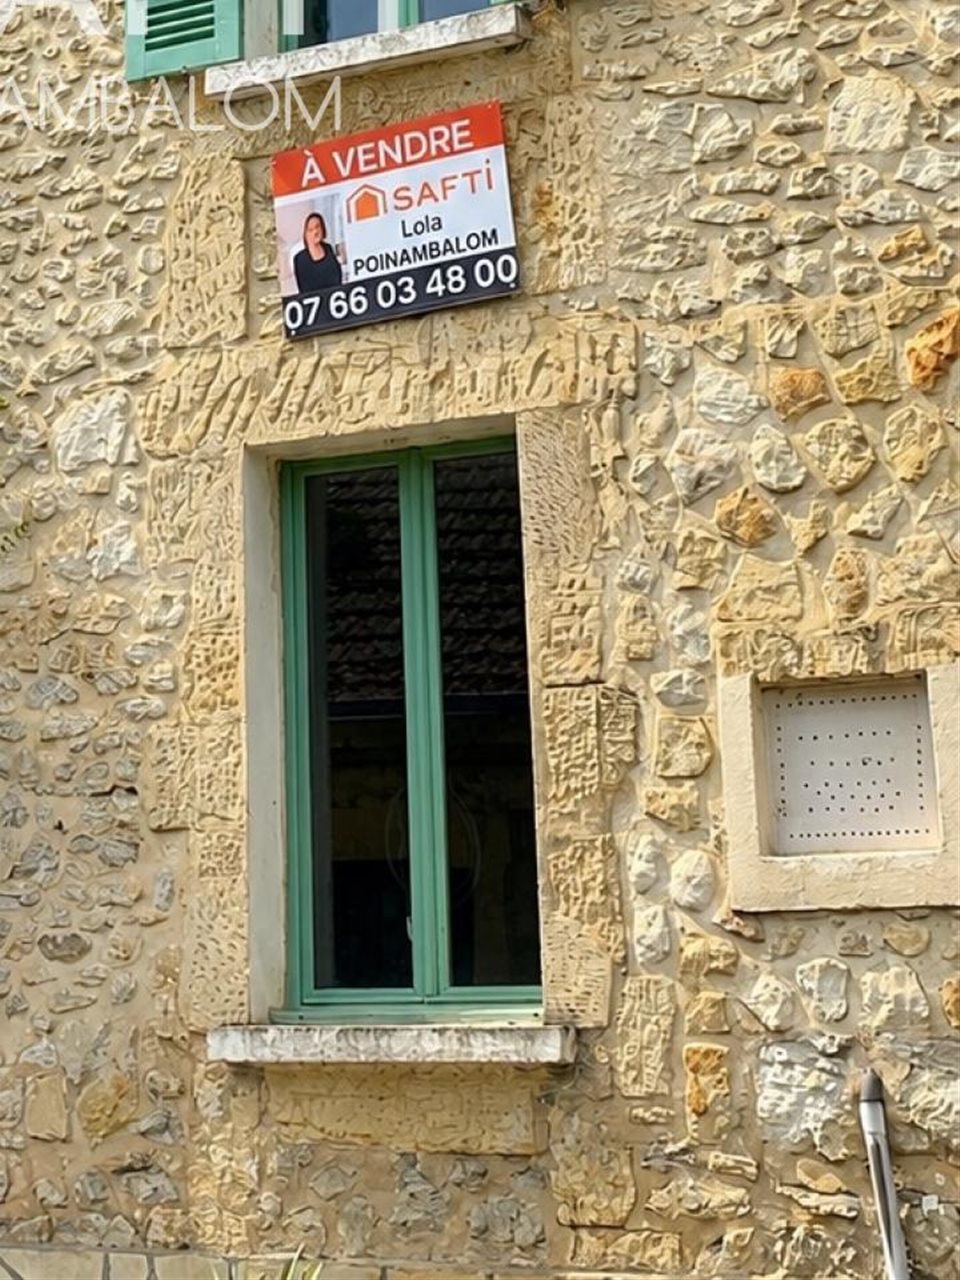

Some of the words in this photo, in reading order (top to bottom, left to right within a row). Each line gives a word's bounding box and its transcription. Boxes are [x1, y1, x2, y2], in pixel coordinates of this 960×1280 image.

[301, 149, 325, 187] À
[332, 120, 474, 178] VENDRE
[353, 228, 499, 276] POINAMBALOM
[401, 214, 442, 238] Lola
[285, 297, 320, 330] 07
[329, 286, 368, 319] 66
[377, 276, 416, 309] 03
[426, 265, 466, 298] 48
[474, 254, 517, 287] 00
